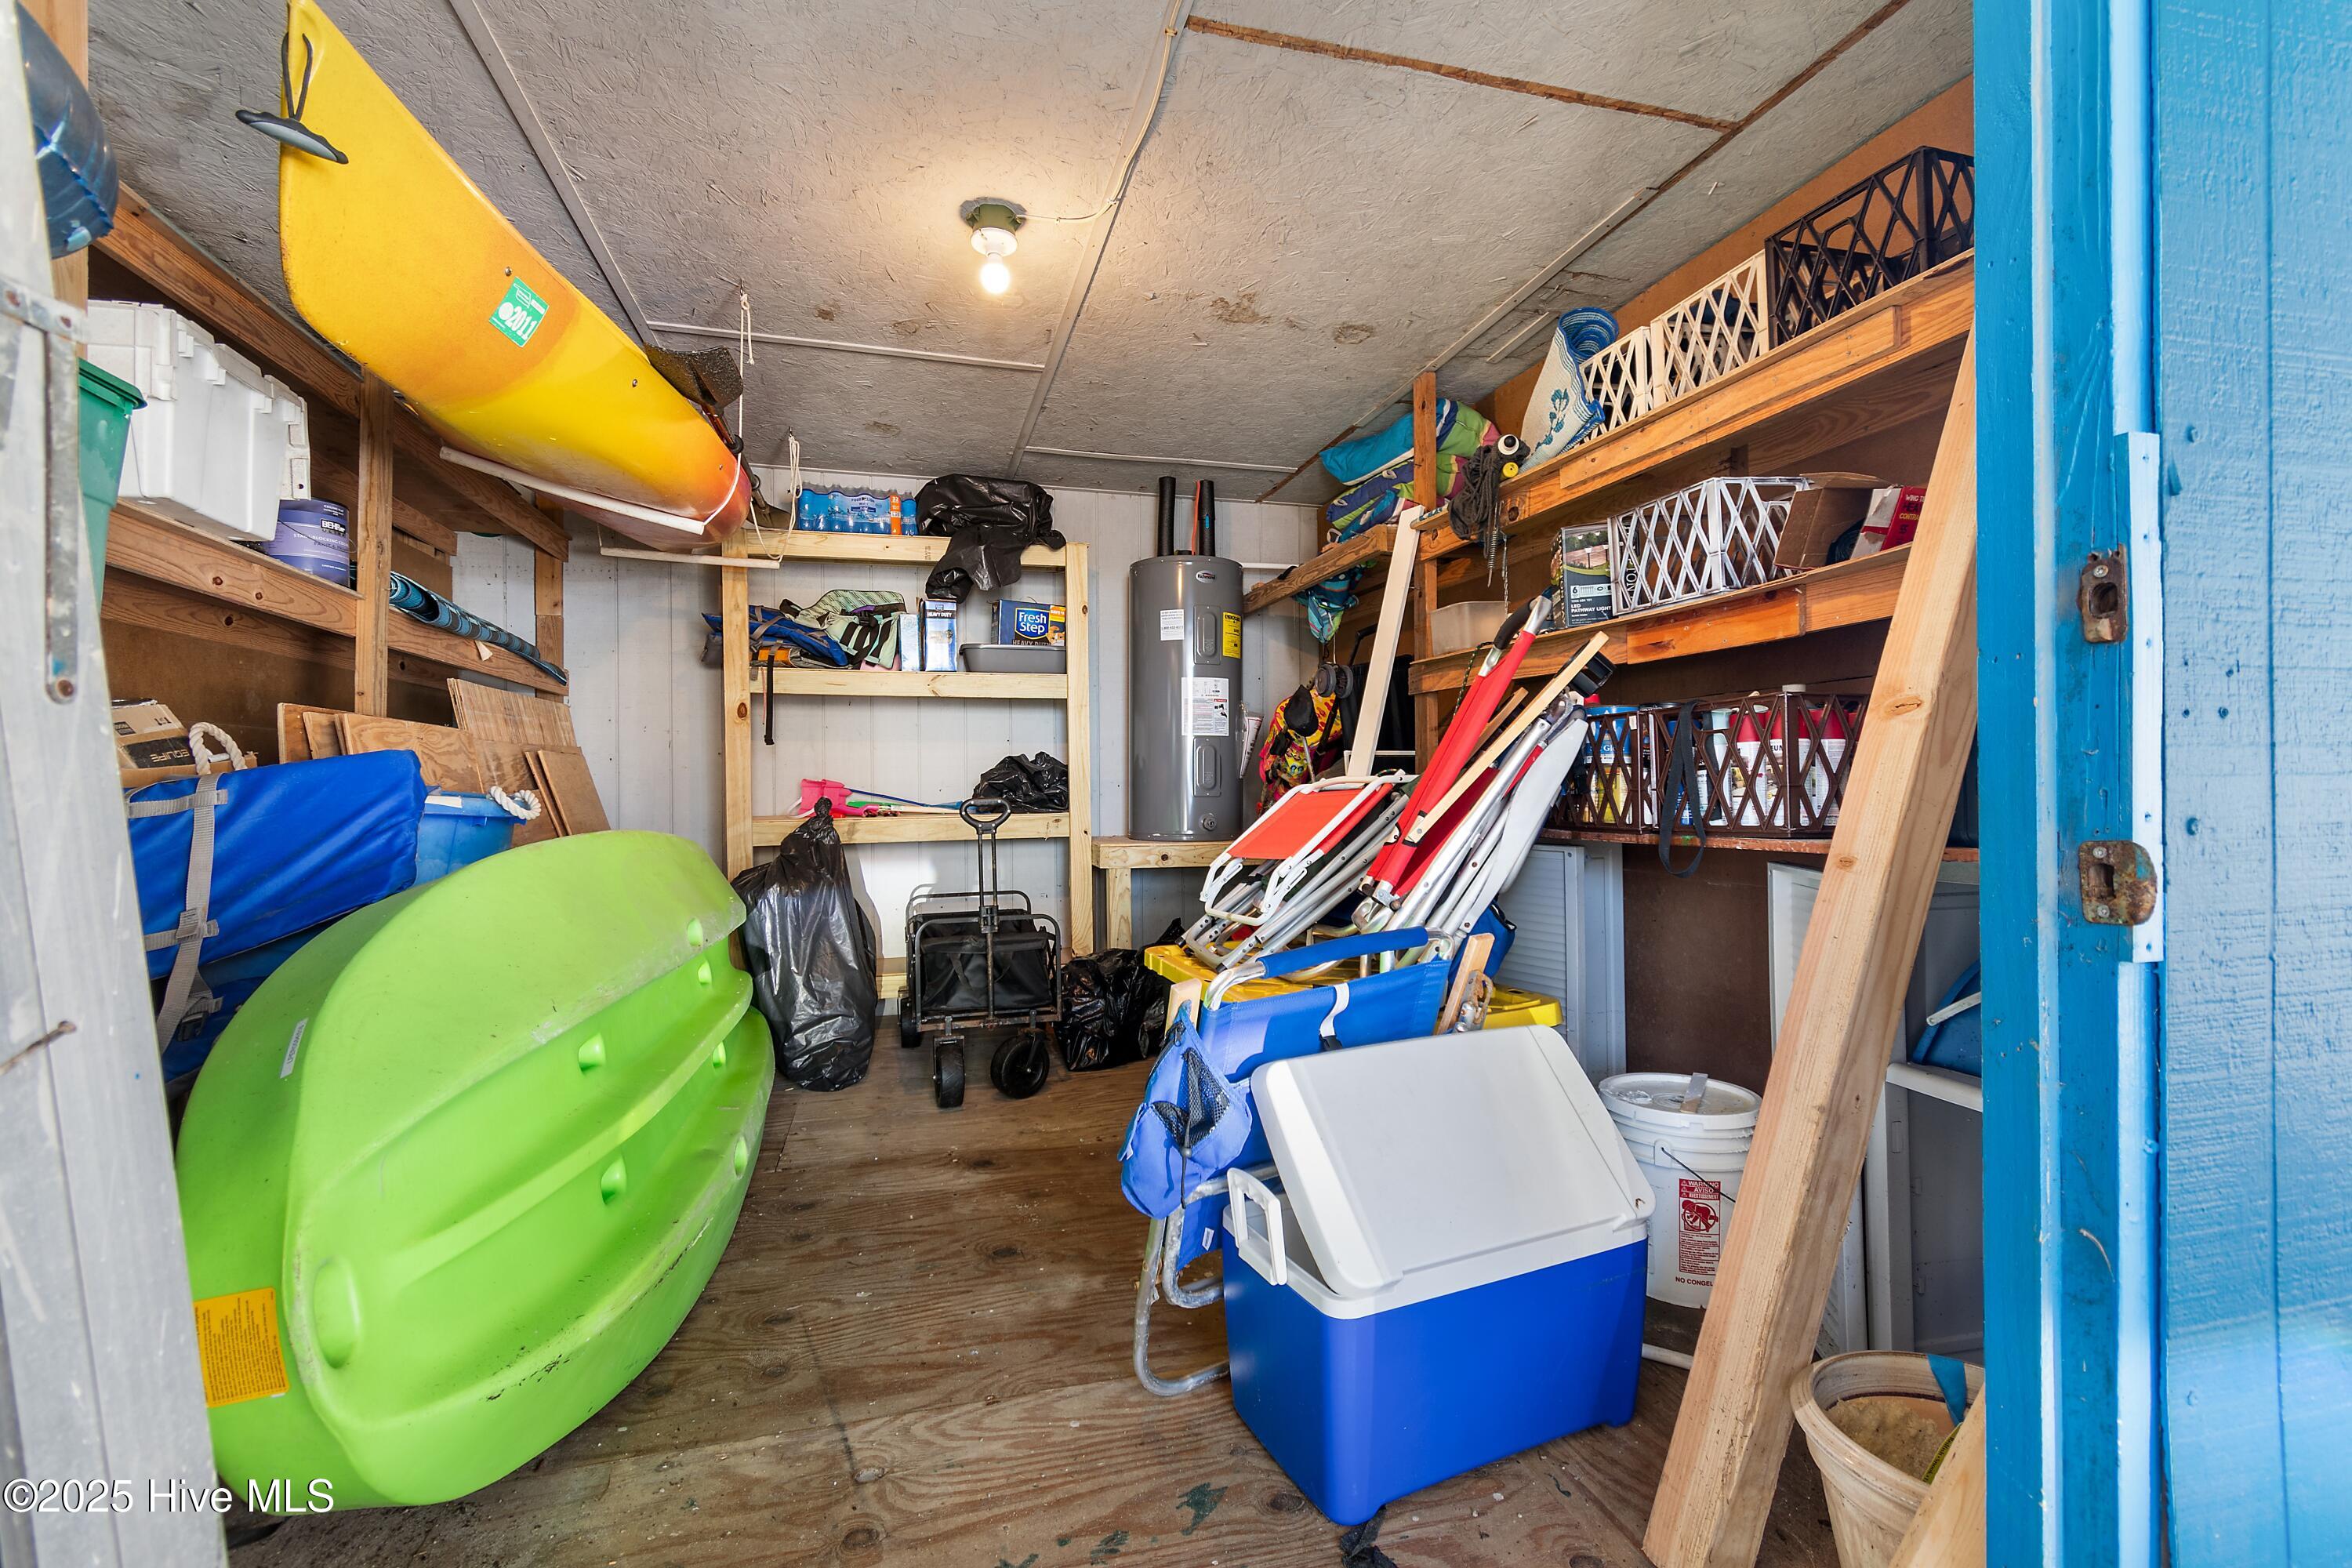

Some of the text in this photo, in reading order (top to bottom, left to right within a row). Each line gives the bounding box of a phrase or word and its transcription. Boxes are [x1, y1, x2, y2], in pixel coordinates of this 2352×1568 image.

[505, 306, 538, 340] 2011
[321, 520, 340, 531] BEHR
[1018, 612, 1047, 624] Fresh
[1019, 622, 1045, 635] Step
